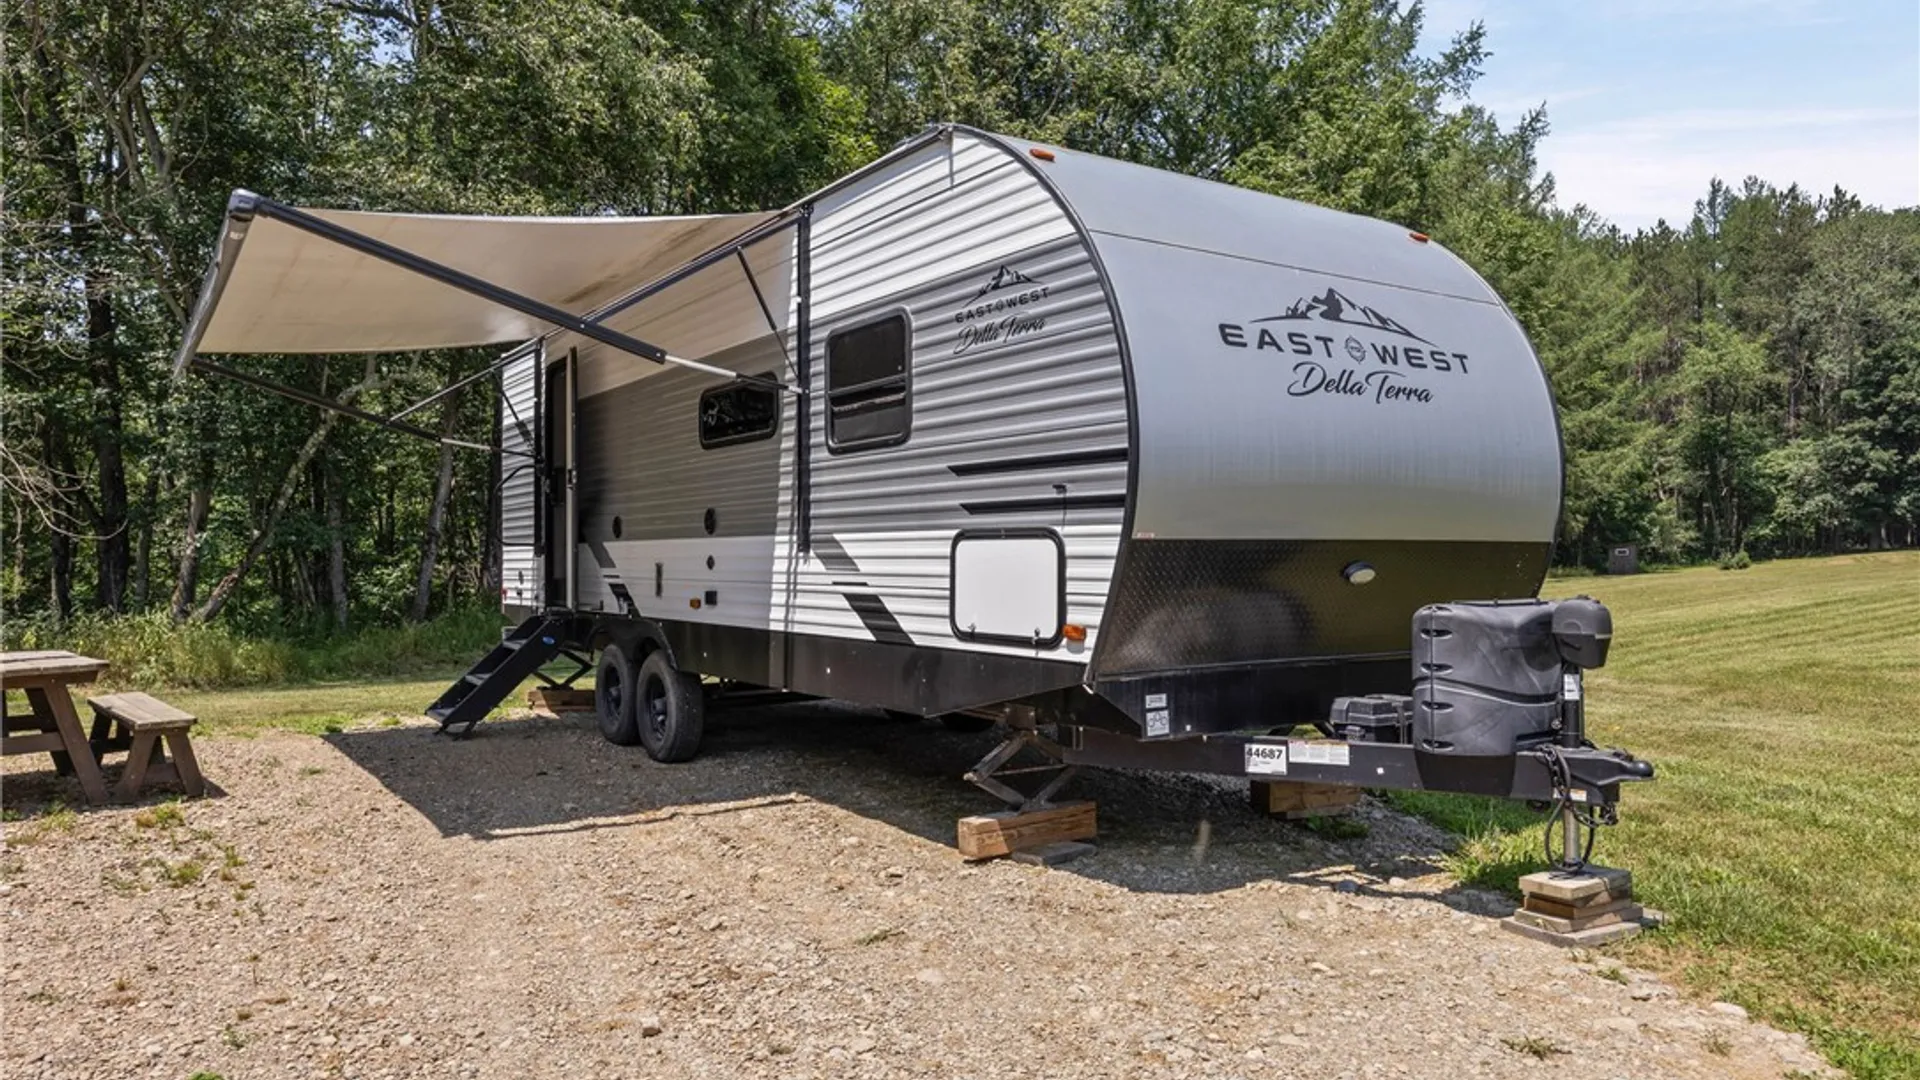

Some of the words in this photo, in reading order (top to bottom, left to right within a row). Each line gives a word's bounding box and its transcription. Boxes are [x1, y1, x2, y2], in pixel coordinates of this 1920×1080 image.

[955, 303, 992, 323] EAST
[1006, 286, 1050, 309] WEST
[953, 323, 999, 354] Della
[1000, 314, 1046, 343] Terra
[1218, 323, 1334, 358] EAST
[1371, 342, 1469, 374] WEST
[1287, 361, 1367, 397] Della
[1365, 370, 1433, 404] Terra
[1246, 747, 1283, 760] 44687
